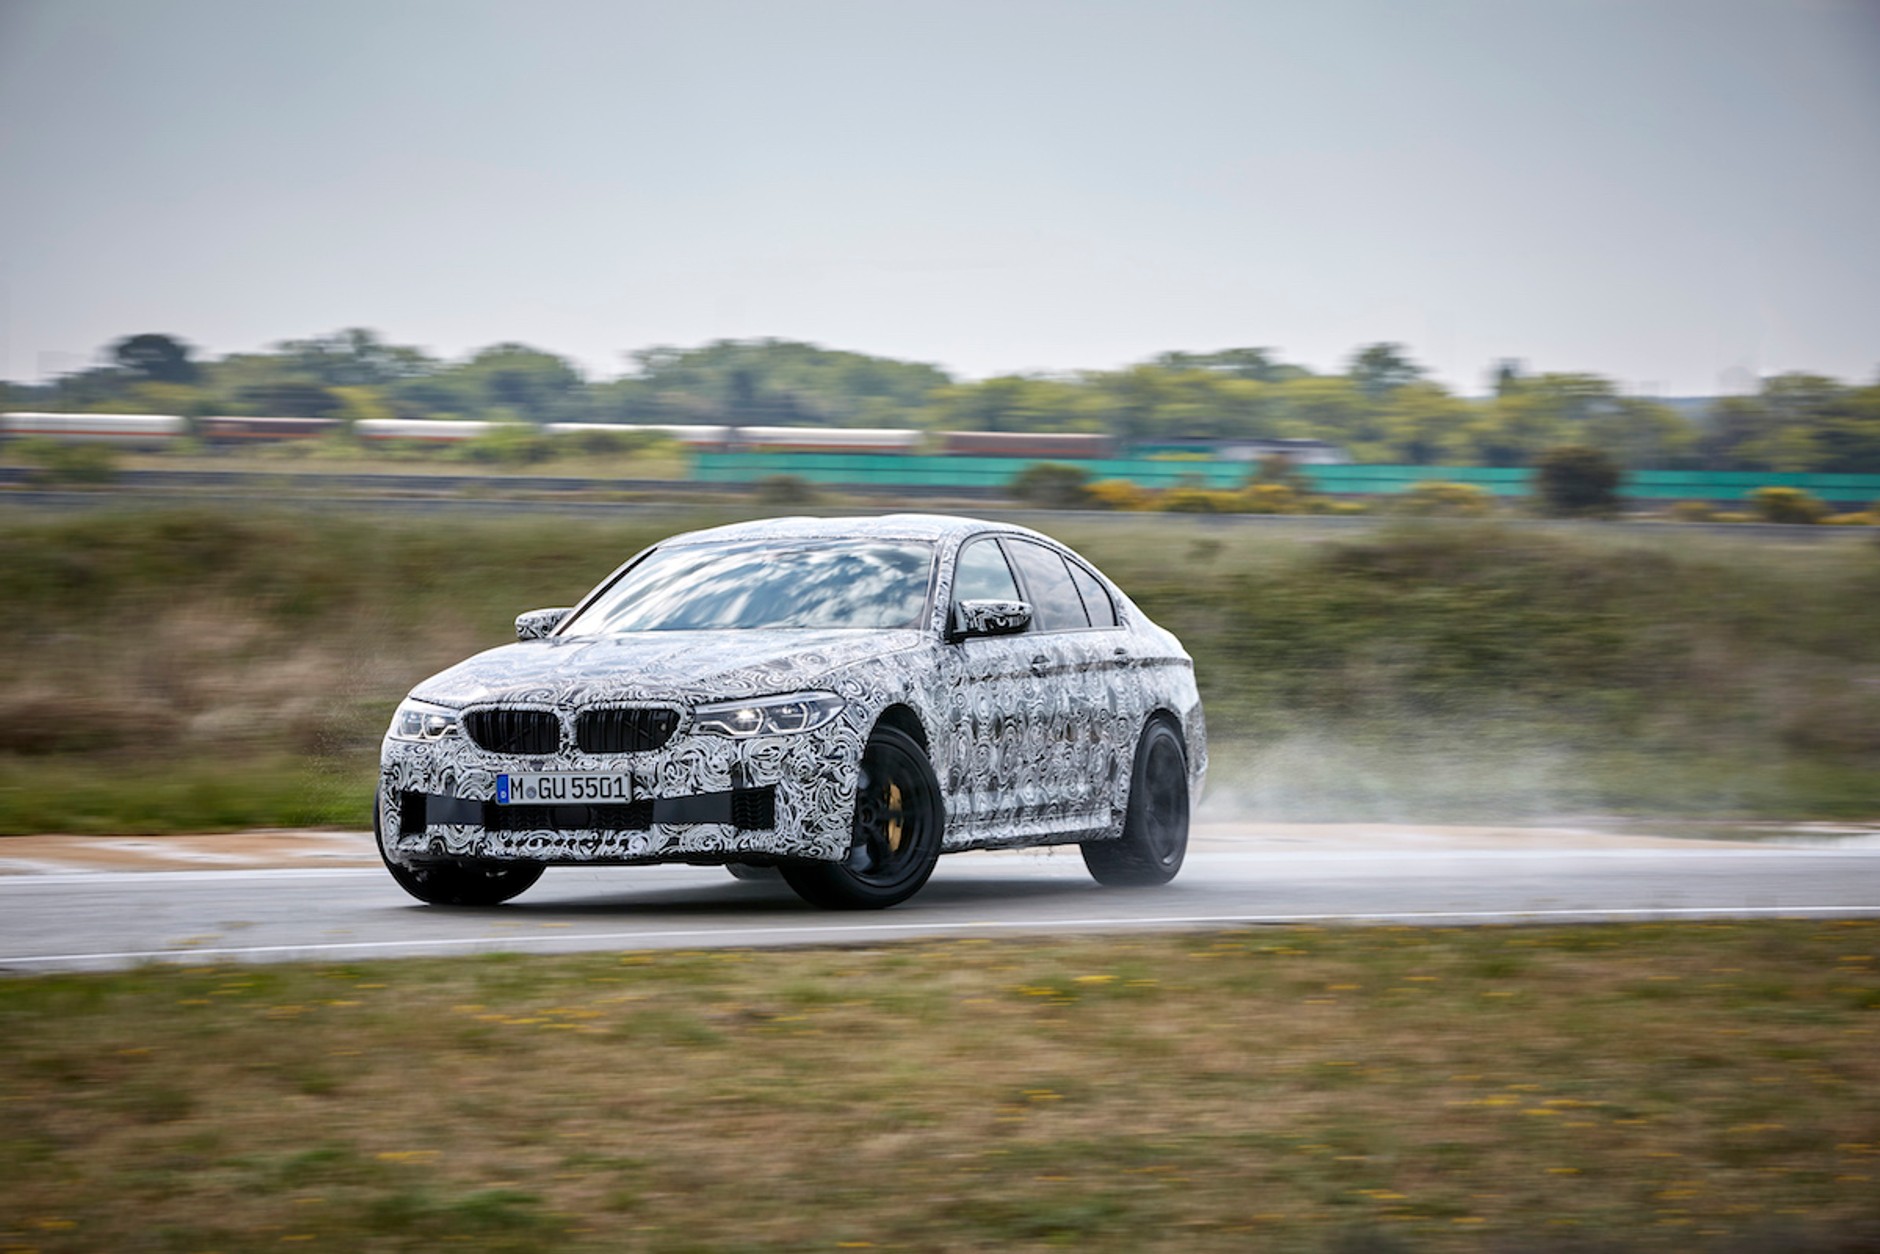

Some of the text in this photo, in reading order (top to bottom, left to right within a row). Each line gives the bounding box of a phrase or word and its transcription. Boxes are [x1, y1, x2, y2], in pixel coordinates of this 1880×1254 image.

[510, 776, 626, 800] M GU 5501
